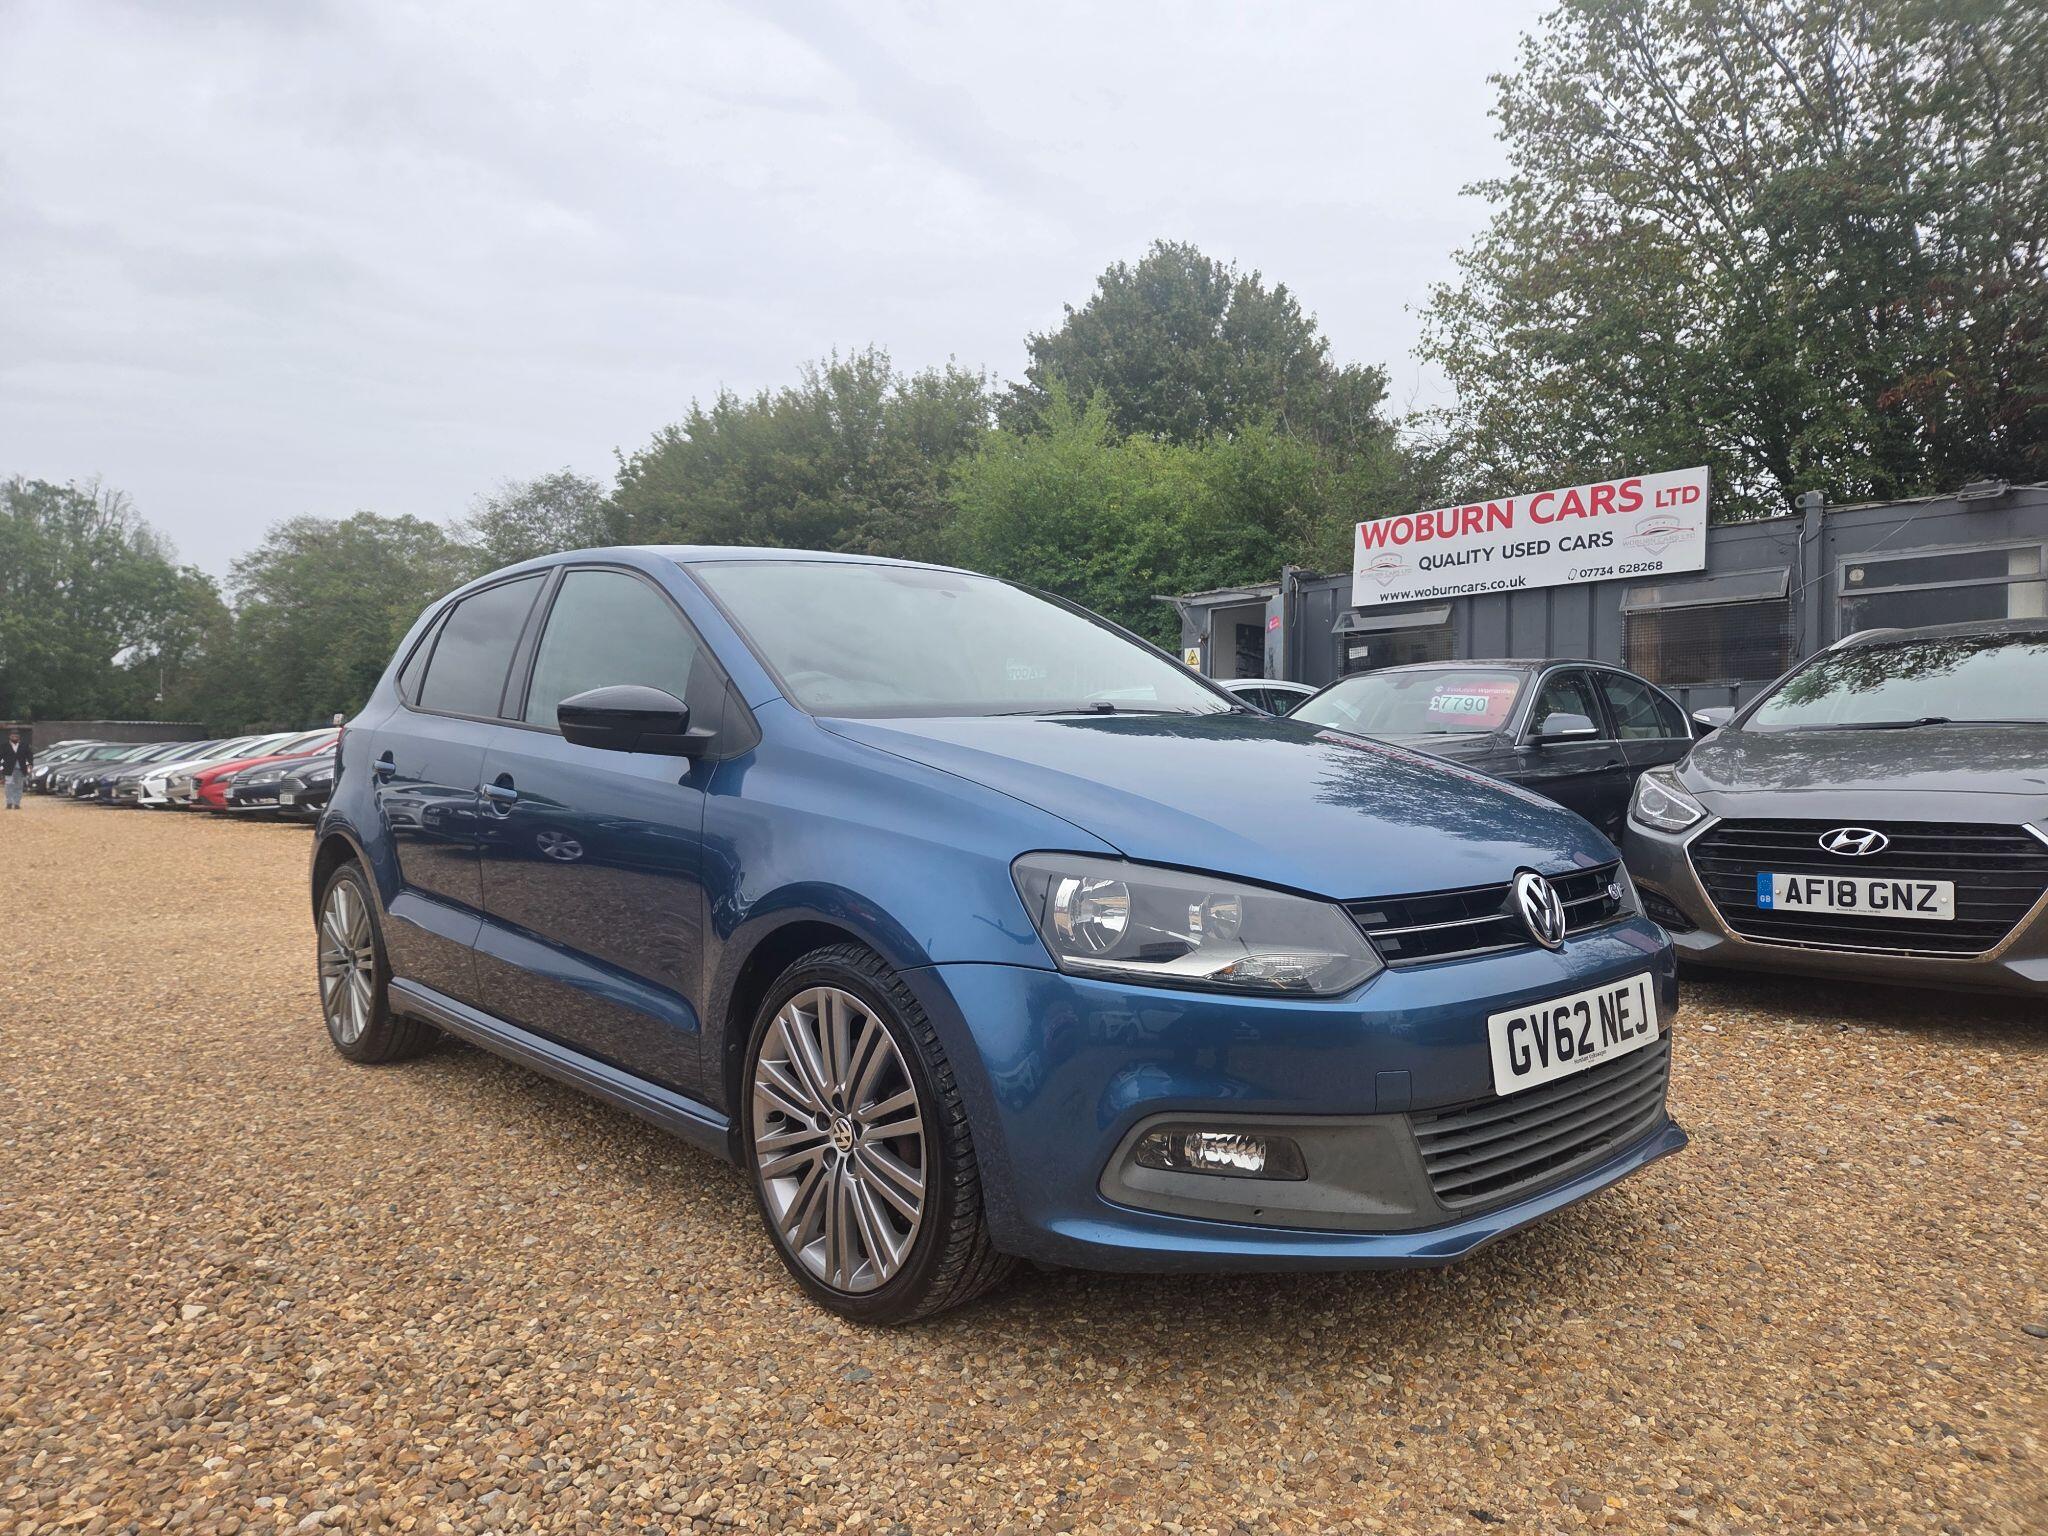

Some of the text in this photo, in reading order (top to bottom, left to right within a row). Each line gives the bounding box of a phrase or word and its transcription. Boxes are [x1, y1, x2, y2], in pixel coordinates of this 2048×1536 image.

[1361, 479, 1701, 549] WOBURN CARS LTD
[1418, 531, 1614, 571] QUALITY USED CARS
[1579, 561, 1664, 578] 07734 628268
[1379, 576, 1527, 602] www.woburncars.co.uk
[1429, 695, 1487, 712] £7790
[1760, 895, 1771, 903] GB
[1785, 878, 1938, 912] AF18 GNZ
[1506, 982, 1649, 1076] GV62 NEJ
